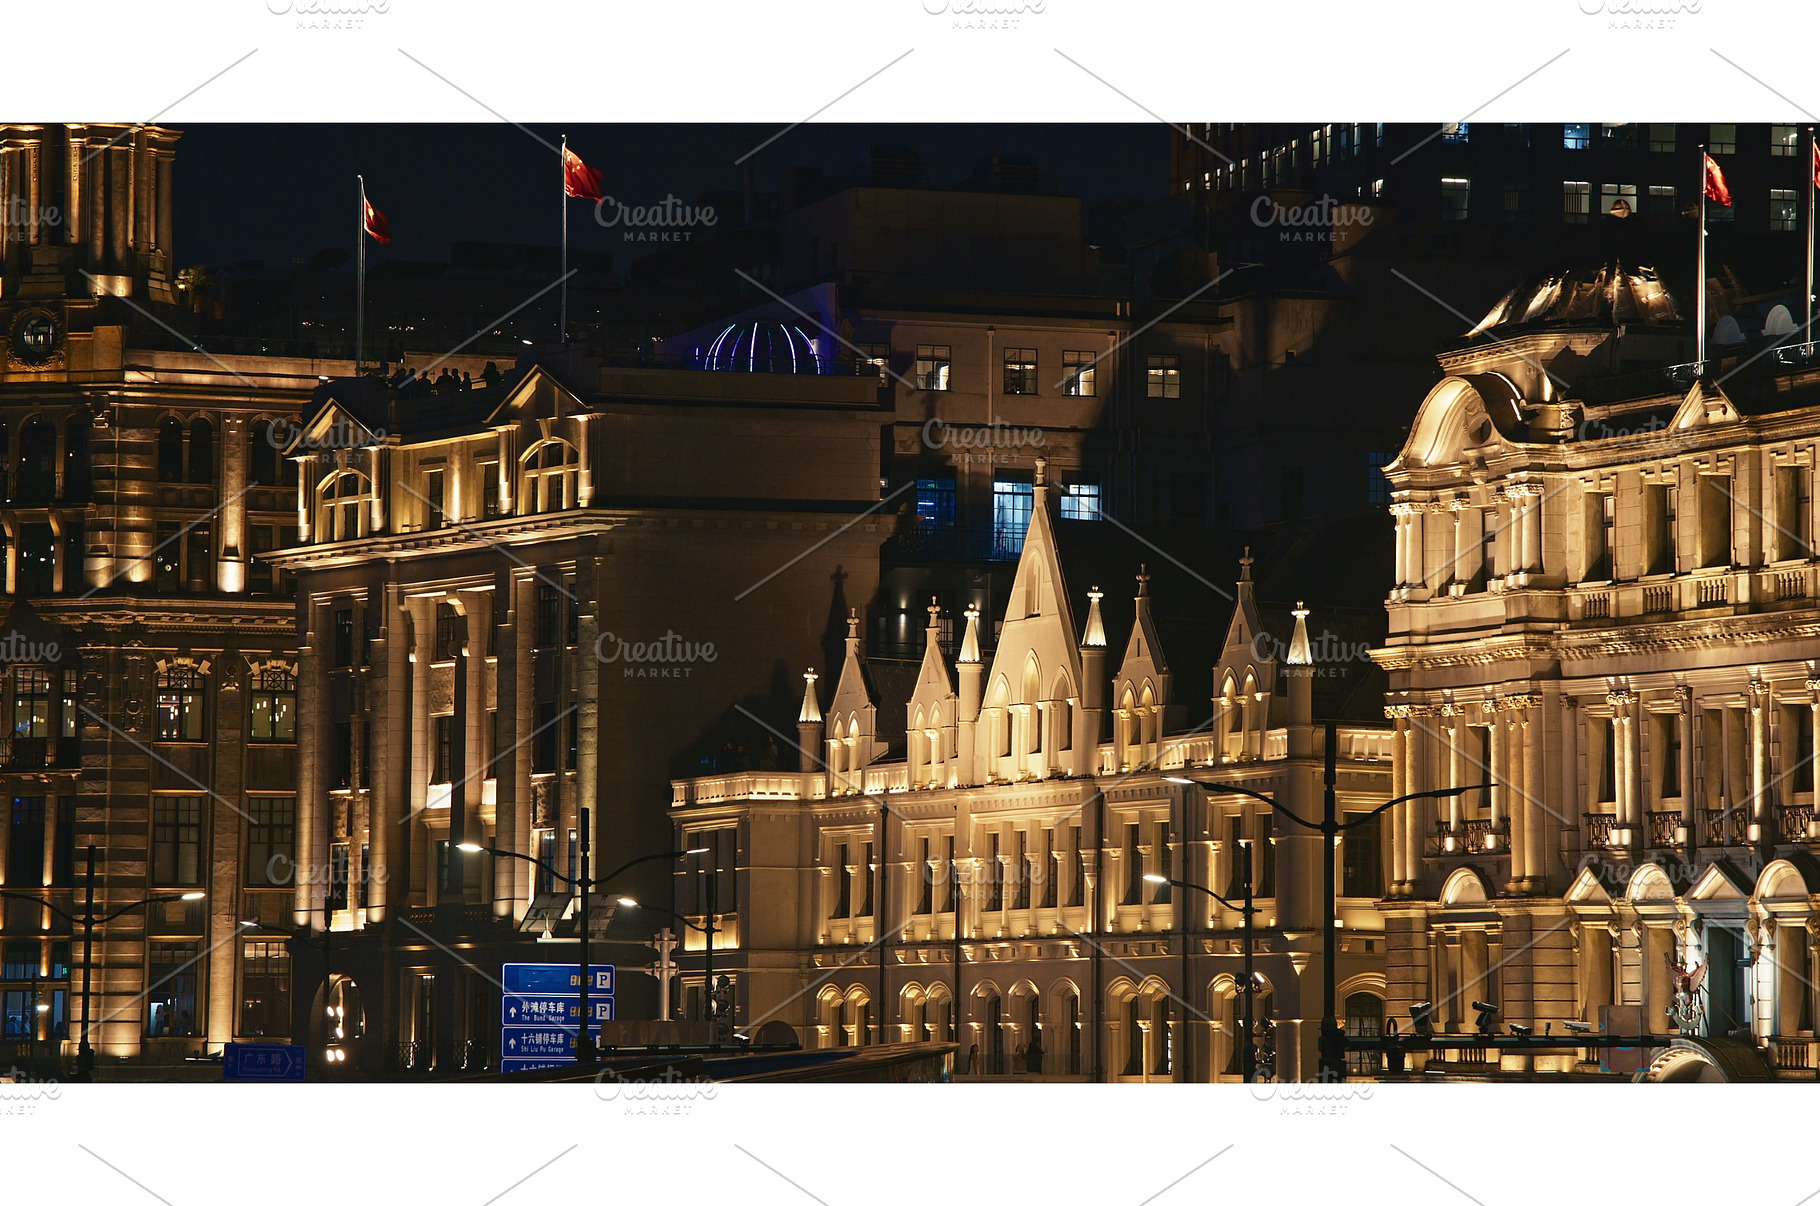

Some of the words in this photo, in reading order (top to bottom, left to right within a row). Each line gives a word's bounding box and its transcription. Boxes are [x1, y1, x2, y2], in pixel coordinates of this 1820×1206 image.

[521, 1001, 565, 1014] 外滩停车库
[548, 1014, 565, 1023] Garage
[521, 1032, 564, 1045] 十六铺停车库
[521, 1045, 529, 1053] Shi
[530, 1045, 539, 1053] Liu
[540, 1045, 547, 1053] Pu
[548, 1045, 564, 1054] Garage
[243, 1052, 282, 1065] 广东路
